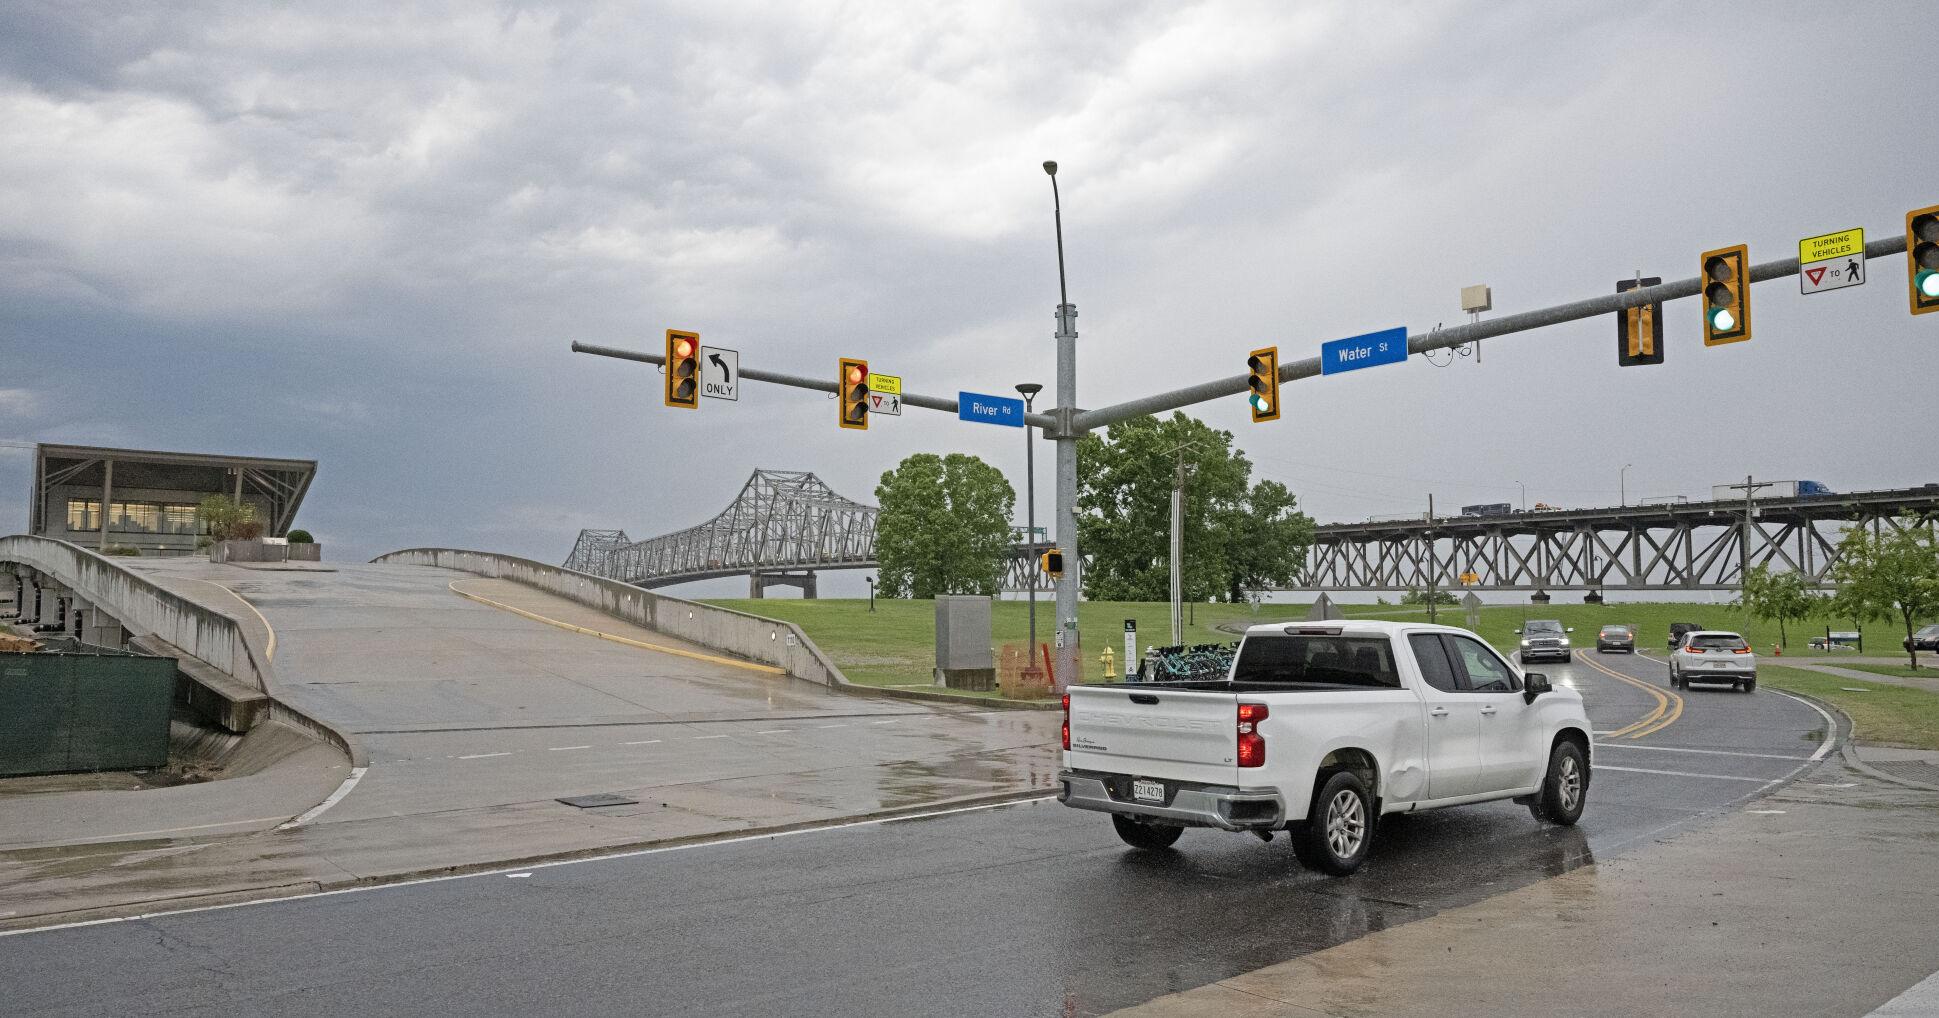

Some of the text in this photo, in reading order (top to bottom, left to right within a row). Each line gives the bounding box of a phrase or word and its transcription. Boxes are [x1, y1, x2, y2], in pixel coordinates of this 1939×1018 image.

[1813, 235, 1850, 248] TURNING
[1812, 245, 1851, 258] VEHICLES
[1830, 269, 1840, 278] TO
[1338, 342, 1388, 362] Water St
[706, 383, 733, 396] ONLY
[973, 402, 1011, 416] River Rd
